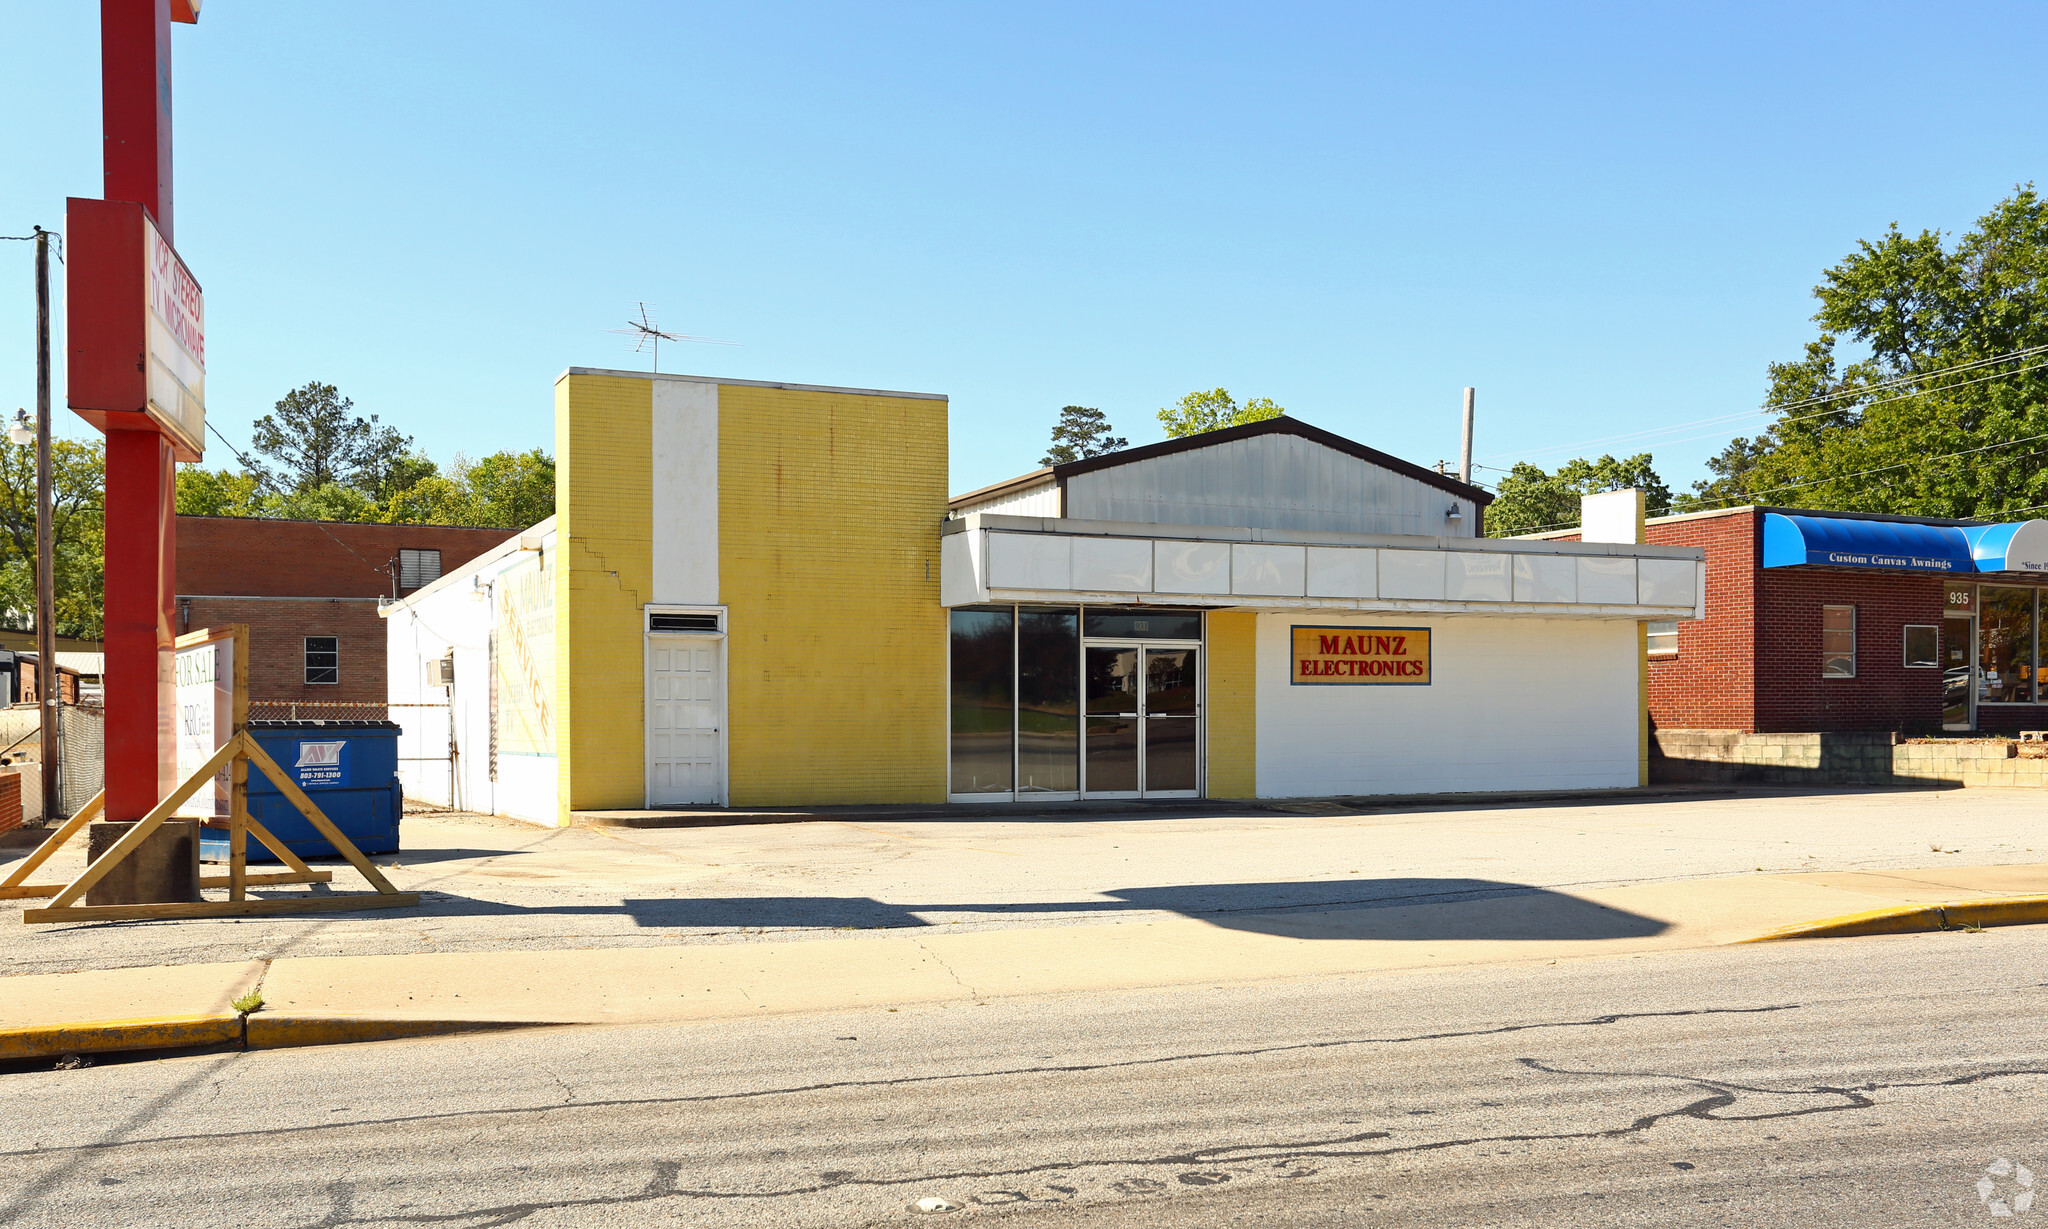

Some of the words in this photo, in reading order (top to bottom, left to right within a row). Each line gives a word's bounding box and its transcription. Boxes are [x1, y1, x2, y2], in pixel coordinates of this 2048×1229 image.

[155, 230, 169, 282] VCR
[172, 260, 201, 323] STEREO
[151, 269, 160, 312] TV
[164, 289, 205, 367] MICROWAVE
[1829, 552, 1868, 564] Custom
[1871, 555, 1907, 567] Canvas
[1911, 557, 1952, 570] Awnings
[519, 563, 553, 616] MAUNZ
[1949, 591, 1969, 605] 935
[1318, 634, 1407, 655] MAUNZ
[175, 655, 193, 688] FOR
[195, 648, 221, 686] SALE
[503, 588, 549, 737] SERVICE
[1300, 659, 1424, 676] ELECTRONICS
[184, 703, 201, 736] RRG
[300, 771, 341, 779] 803-791-1300
